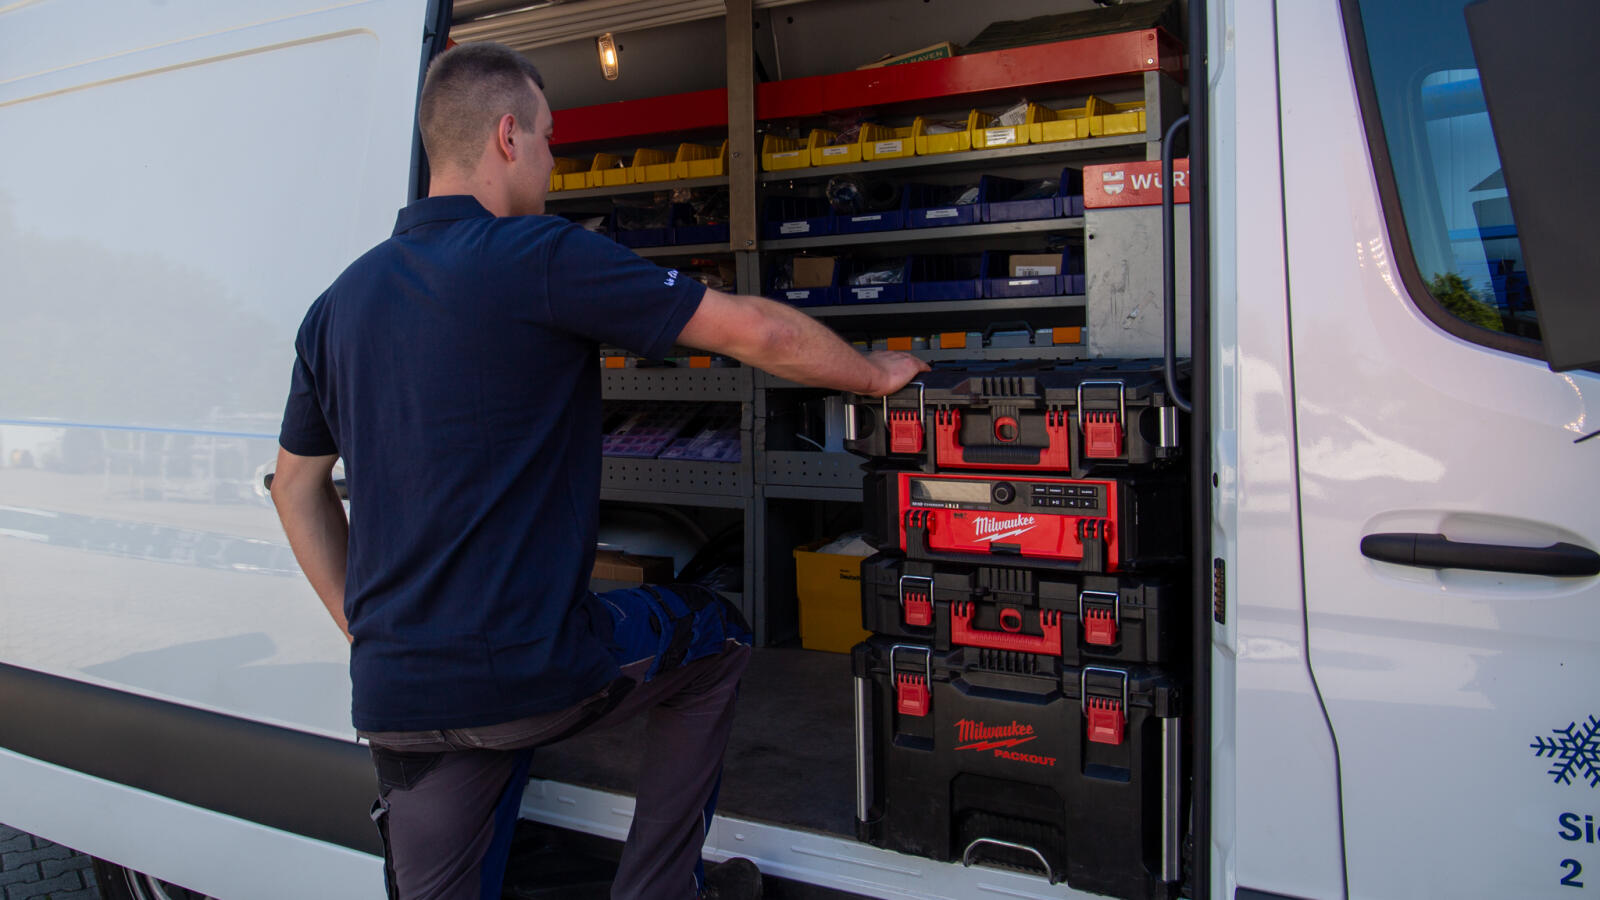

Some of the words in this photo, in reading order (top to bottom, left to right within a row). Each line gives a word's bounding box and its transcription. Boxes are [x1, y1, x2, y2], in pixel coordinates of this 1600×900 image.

[1130, 169, 1190, 190] WÜR
[972, 514, 1036, 537] Milwaukee
[953, 719, 1034, 742] Milwaukee
[993, 749, 1057, 767] PACKOUT
[1558, 812, 1600, 843] Si
[1560, 858, 1584, 889] 2
